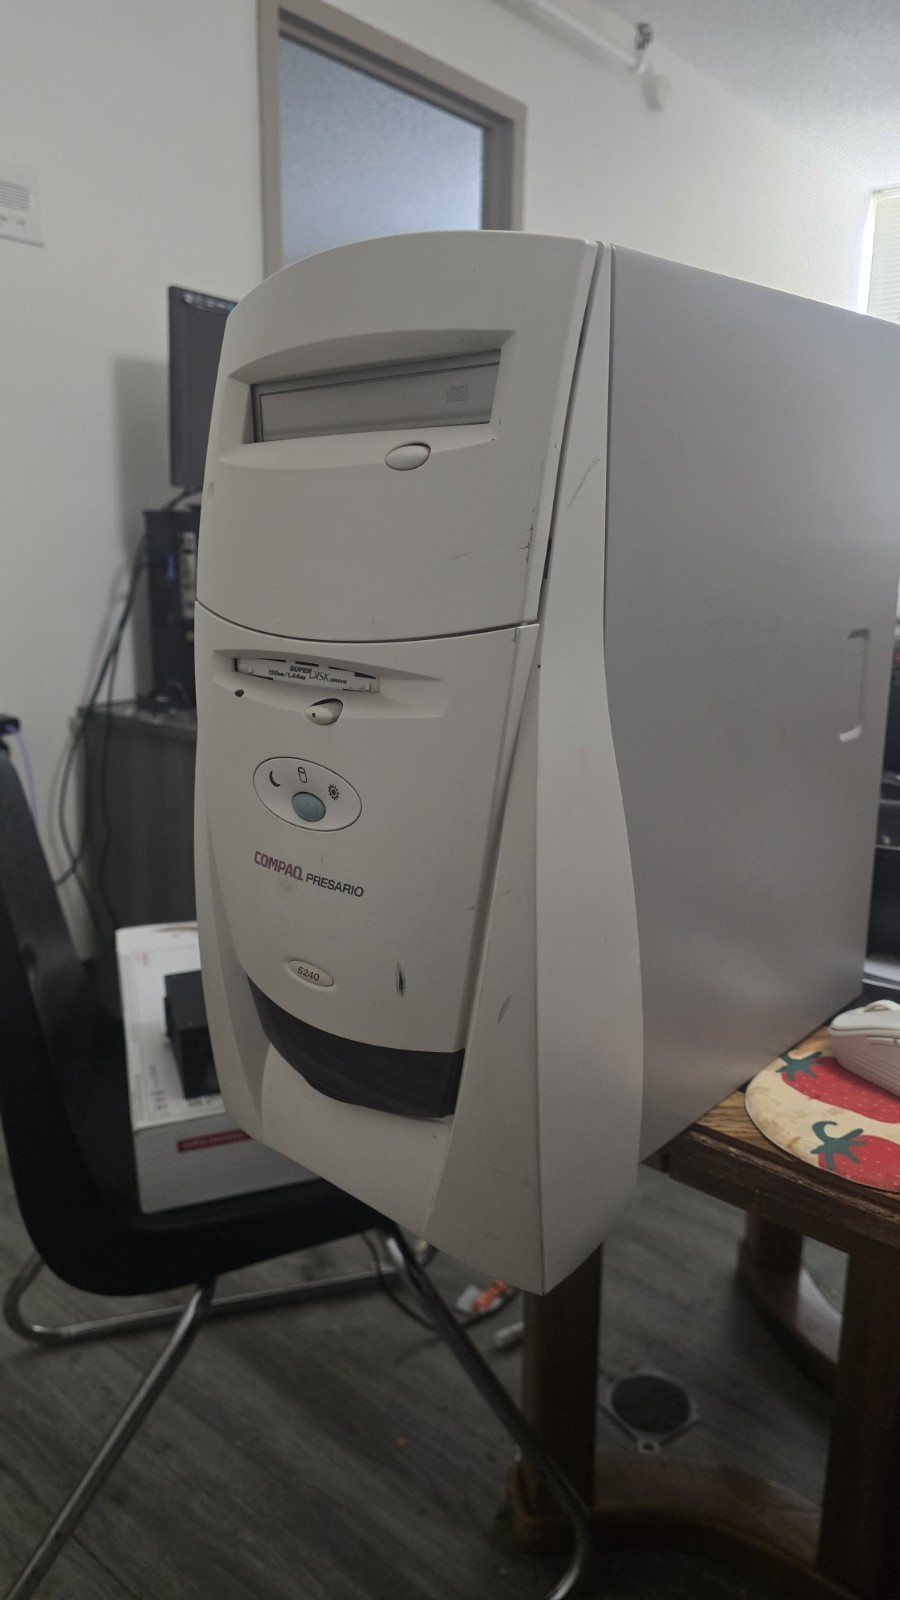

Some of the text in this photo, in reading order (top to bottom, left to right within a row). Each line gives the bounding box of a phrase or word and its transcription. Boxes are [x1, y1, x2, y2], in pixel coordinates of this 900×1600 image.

[289, 665, 312, 674] SUPER
[254, 850, 365, 898] COMPAQ PRESARIO
[297, 966, 320, 982] 5240
